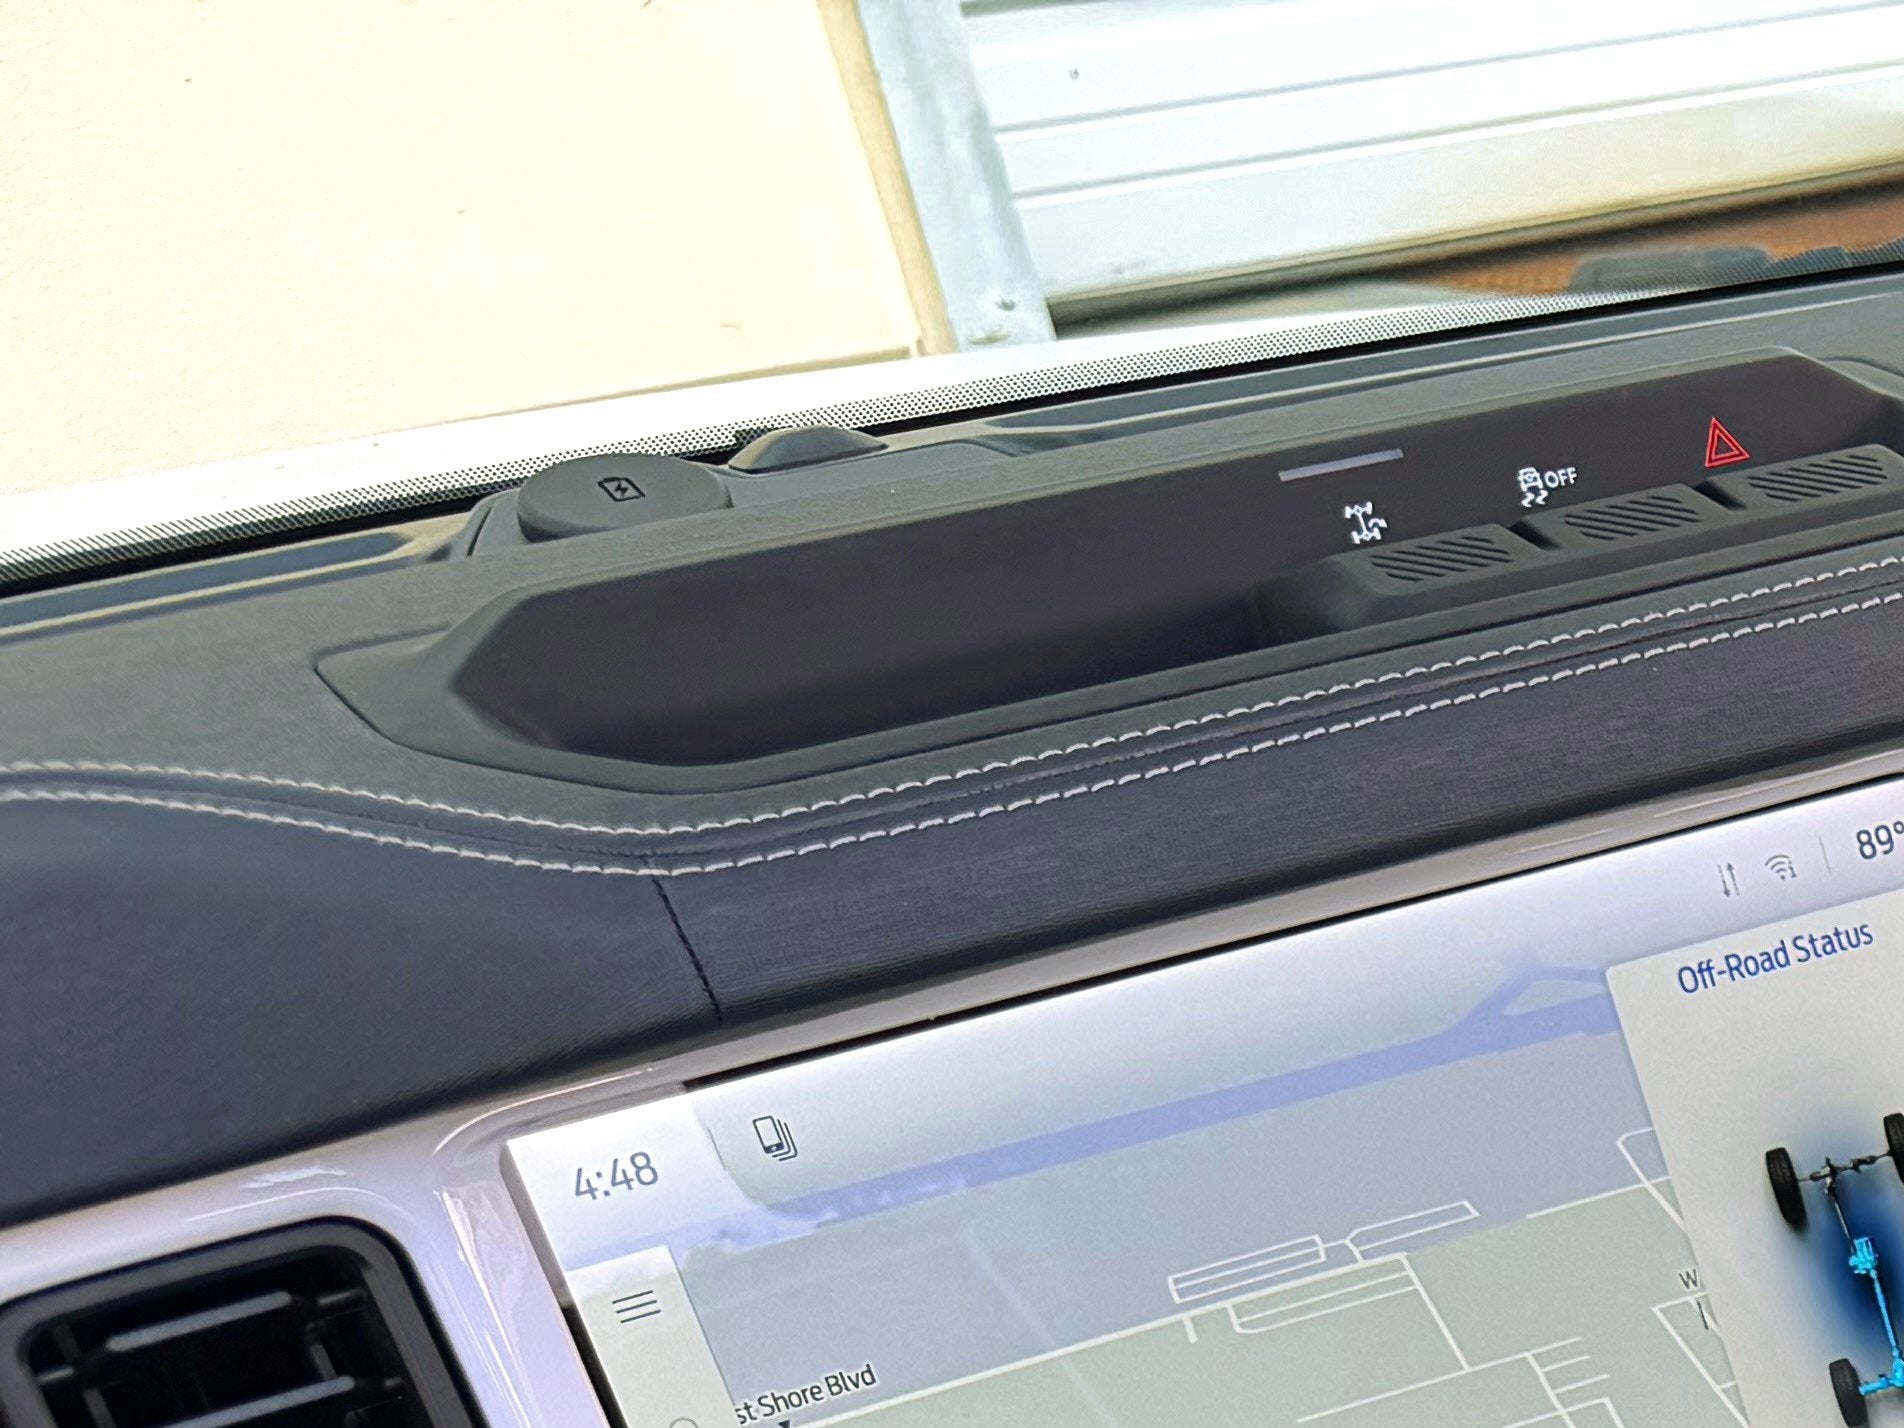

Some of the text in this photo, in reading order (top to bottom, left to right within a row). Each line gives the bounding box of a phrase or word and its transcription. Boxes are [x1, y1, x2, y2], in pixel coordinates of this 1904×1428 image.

[1544, 467, 1577, 488] OFF
[1856, 820, 1904, 860] 89°
[1678, 923, 1874, 995] Off-Road Status
[574, 1151, 660, 1202] 4:48
[735, 1364, 877, 1424] st Shore Blvd
